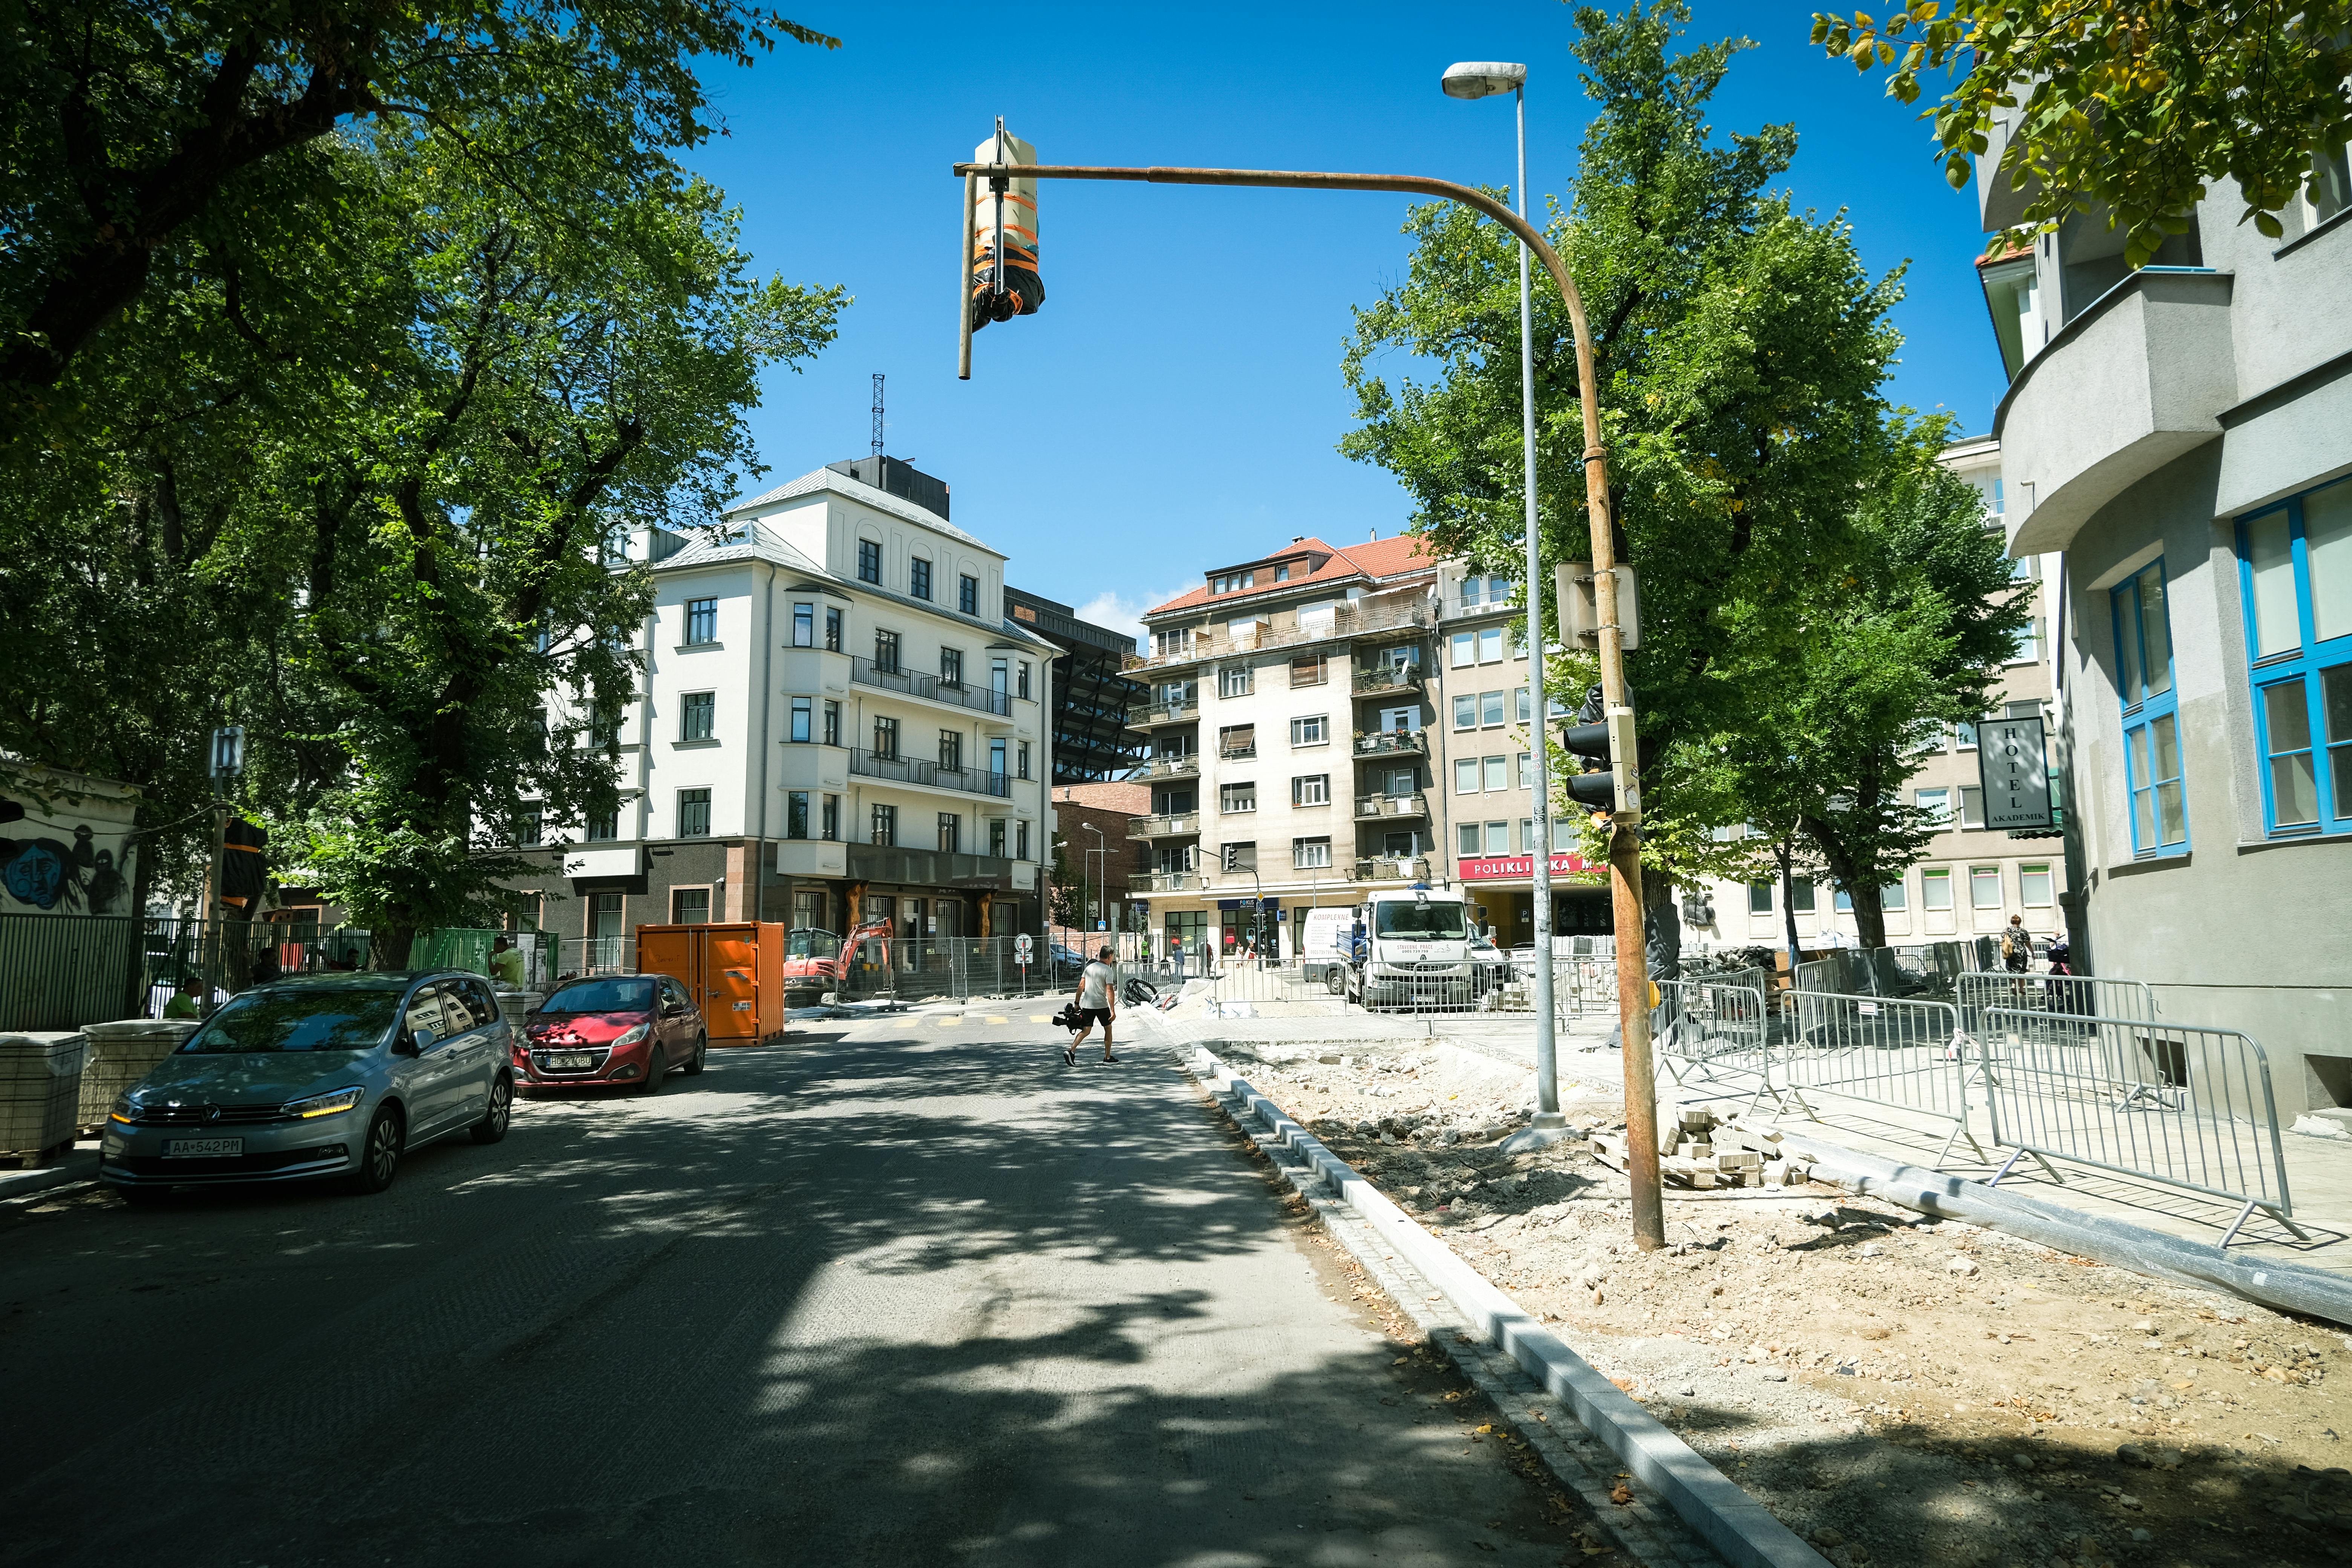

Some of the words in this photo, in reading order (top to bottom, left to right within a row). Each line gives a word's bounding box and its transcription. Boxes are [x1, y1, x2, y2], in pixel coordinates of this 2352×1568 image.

[2003, 727, 2022, 808] HOTEL
[1992, 813, 2045, 822] AKADEMIK
[1475, 859, 1570, 874] POLIKLIKA
[173, 1142, 189, 1153] AA
